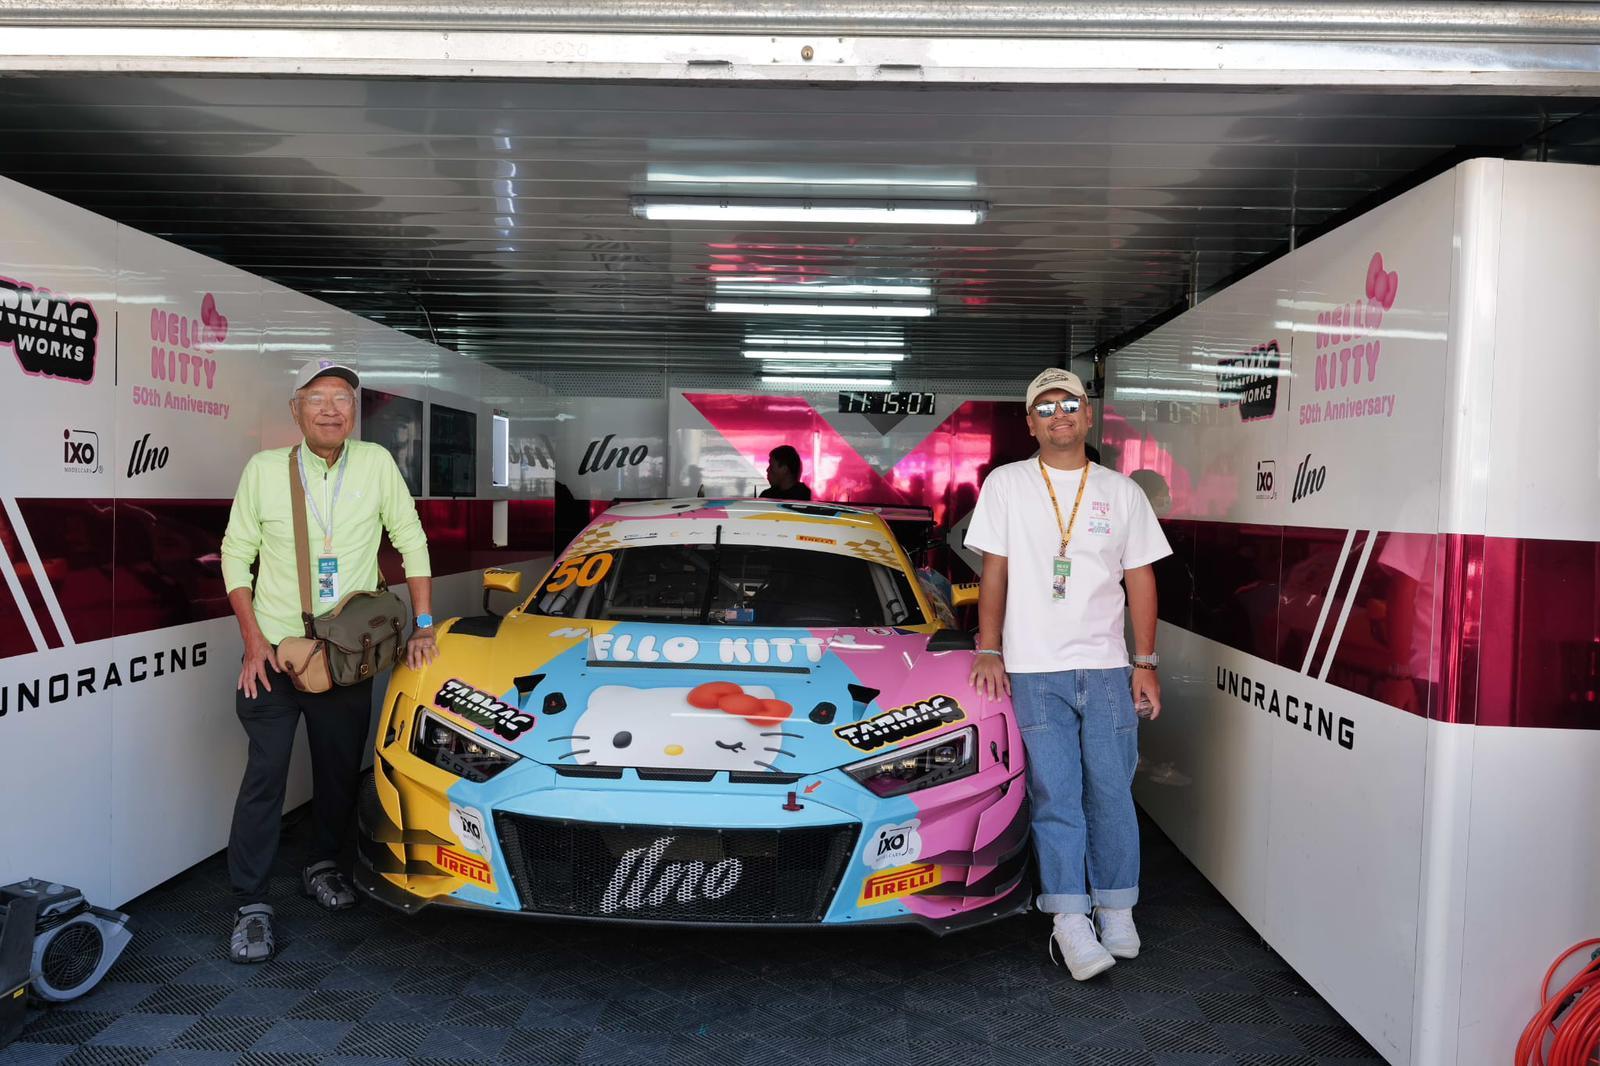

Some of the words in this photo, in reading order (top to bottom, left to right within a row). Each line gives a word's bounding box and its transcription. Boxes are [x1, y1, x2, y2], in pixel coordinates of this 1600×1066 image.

[18, 333, 85, 362] WORKS
[1315, 340, 1380, 392] KITTY
[151, 346, 217, 389] KITTY
[132, 385, 161, 408] 50th
[164, 391, 230, 420] Anniversary
[848, 391, 935, 415] 11:15:07
[1241, 384, 1272, 405] WORKS
[1299, 402, 1322, 425] 50th
[1324, 394, 1396, 421] Anniversary
[547, 553, 614, 592] 50
[439, 681, 531, 731] TARMAC
[839, 697, 953, 744] TARMAC
[1217, 665, 1355, 750] UNORACING
[437, 846, 491, 885] PIRELLI
[864, 863, 936, 900] PIRELLI
